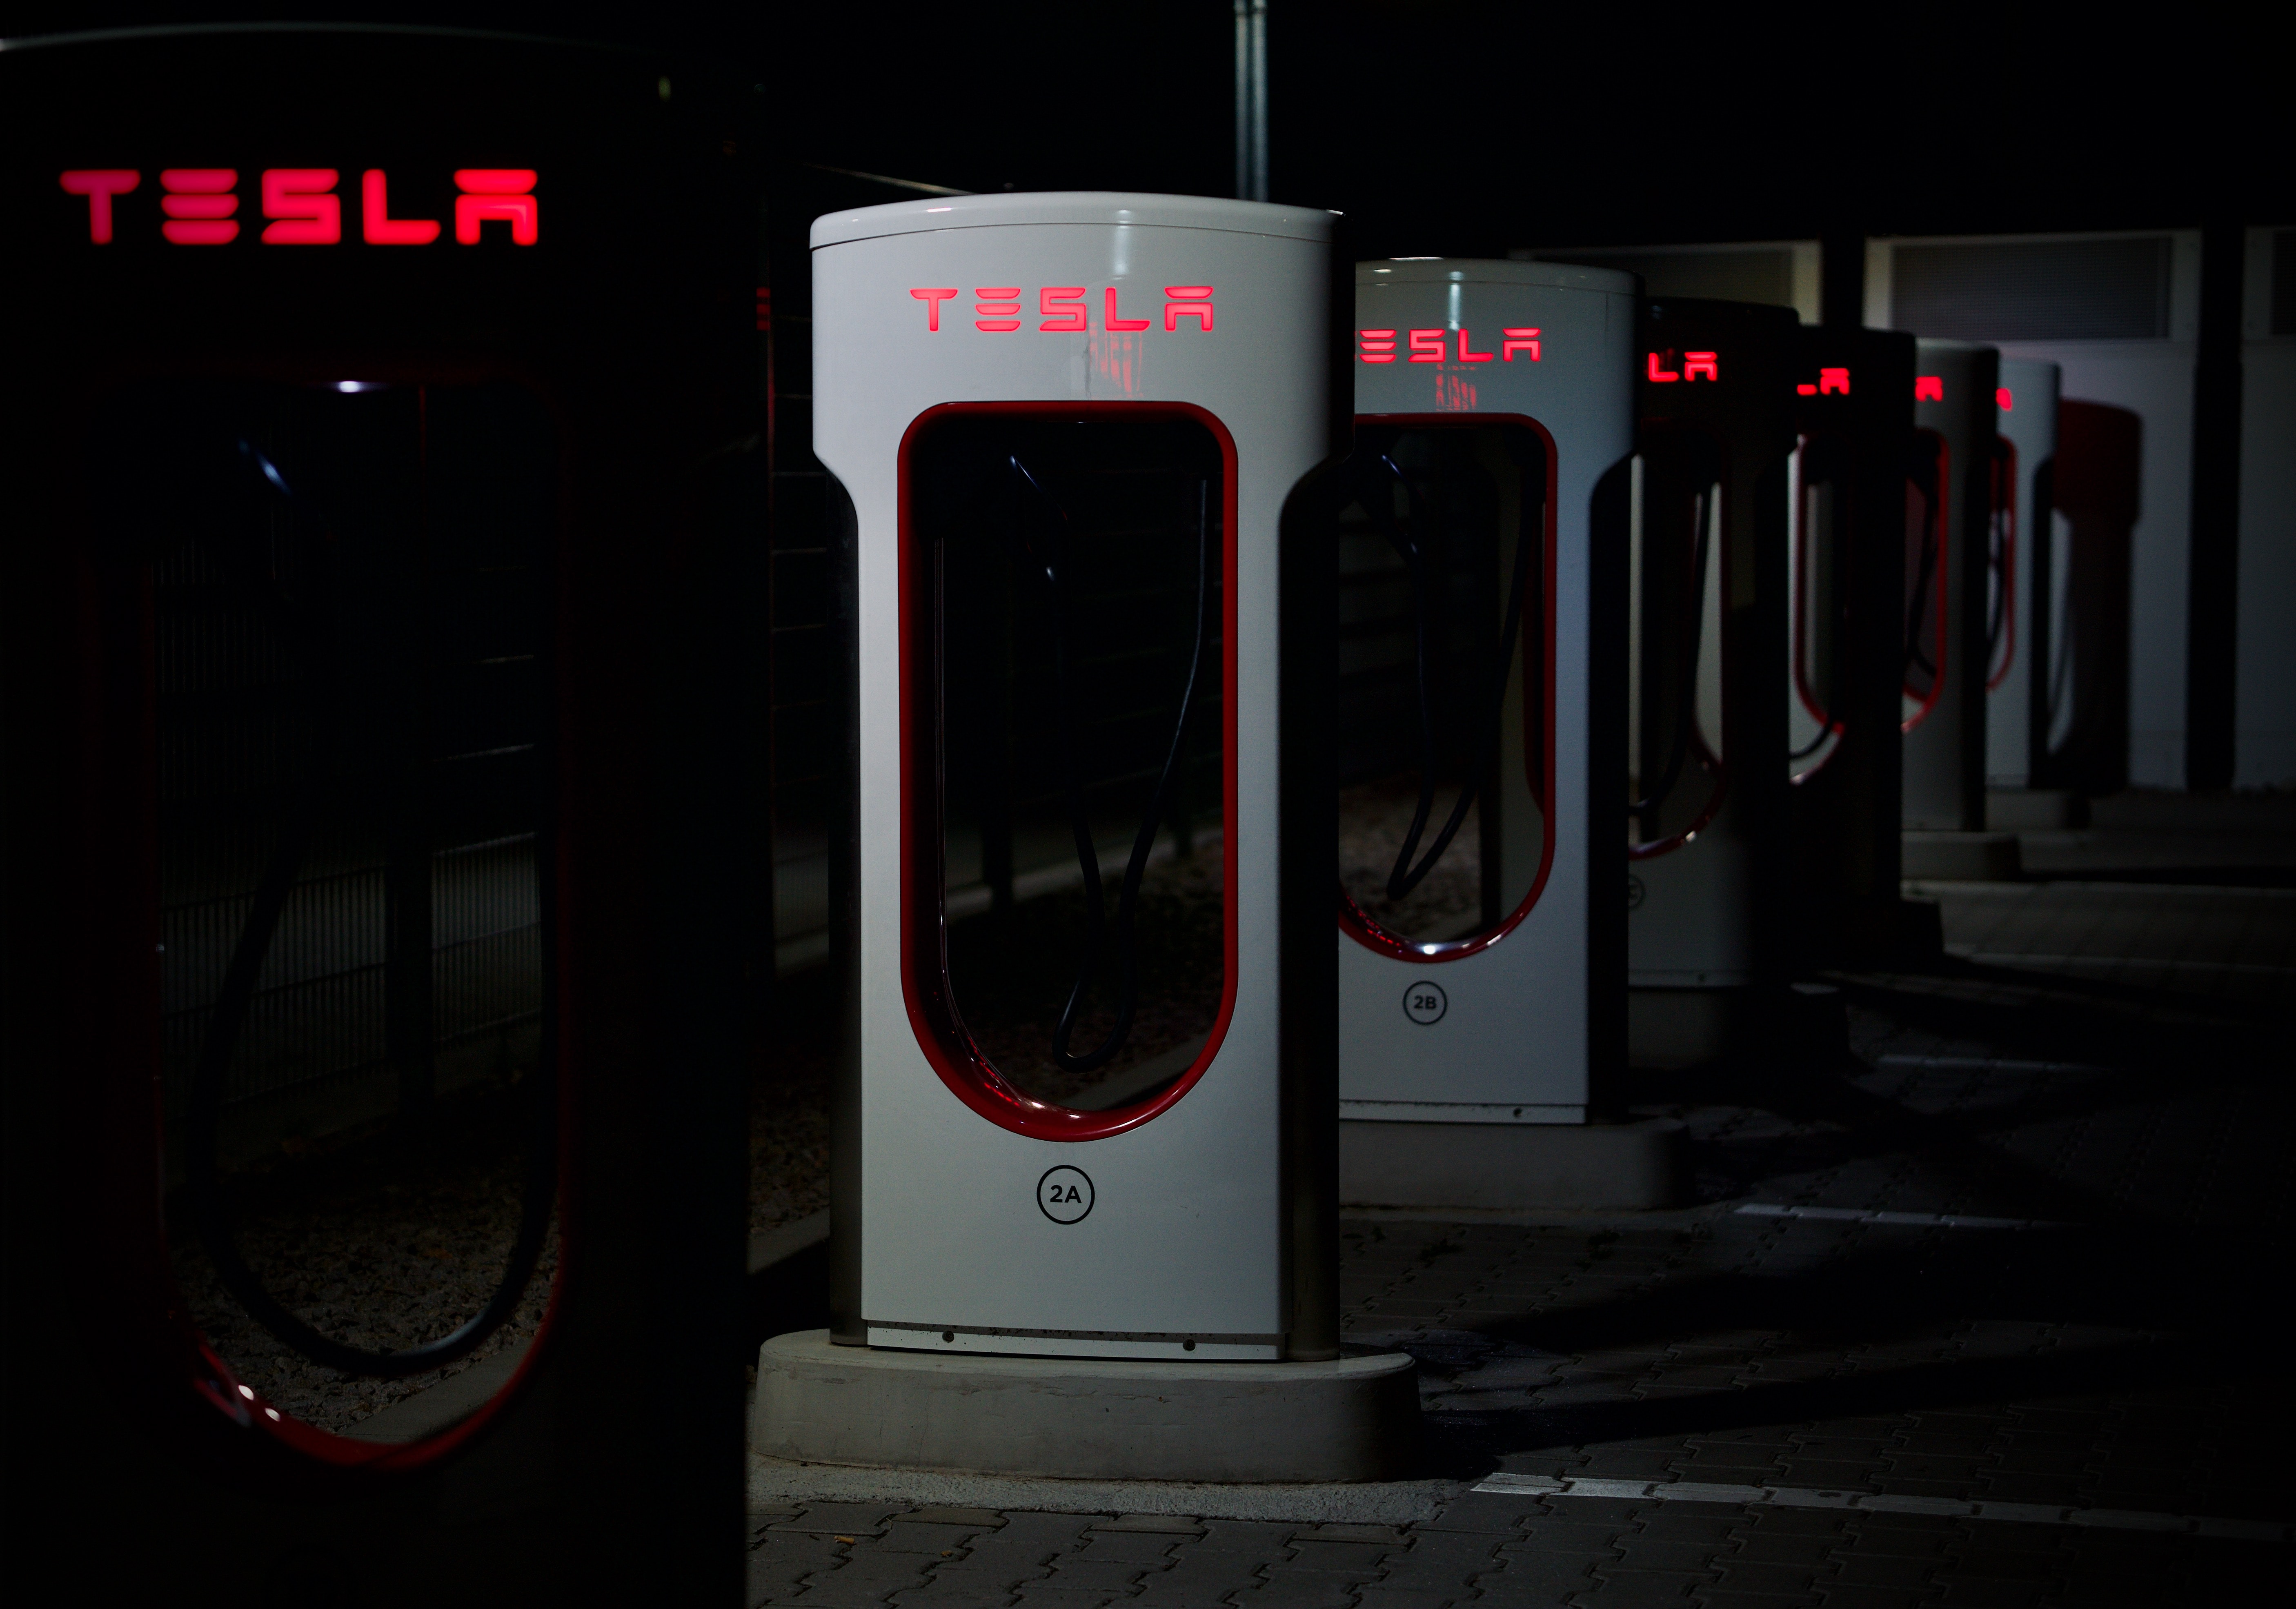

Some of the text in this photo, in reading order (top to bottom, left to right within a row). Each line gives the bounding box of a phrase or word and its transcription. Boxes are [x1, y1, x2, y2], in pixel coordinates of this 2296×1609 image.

[60, 169, 538, 245] TESLA
[910, 286, 1214, 332] TESLA
[1355, 328, 1541, 363] ESLA
[1414, 995, 1436, 1009] 2B
[1050, 1184, 1082, 1204] 2A
